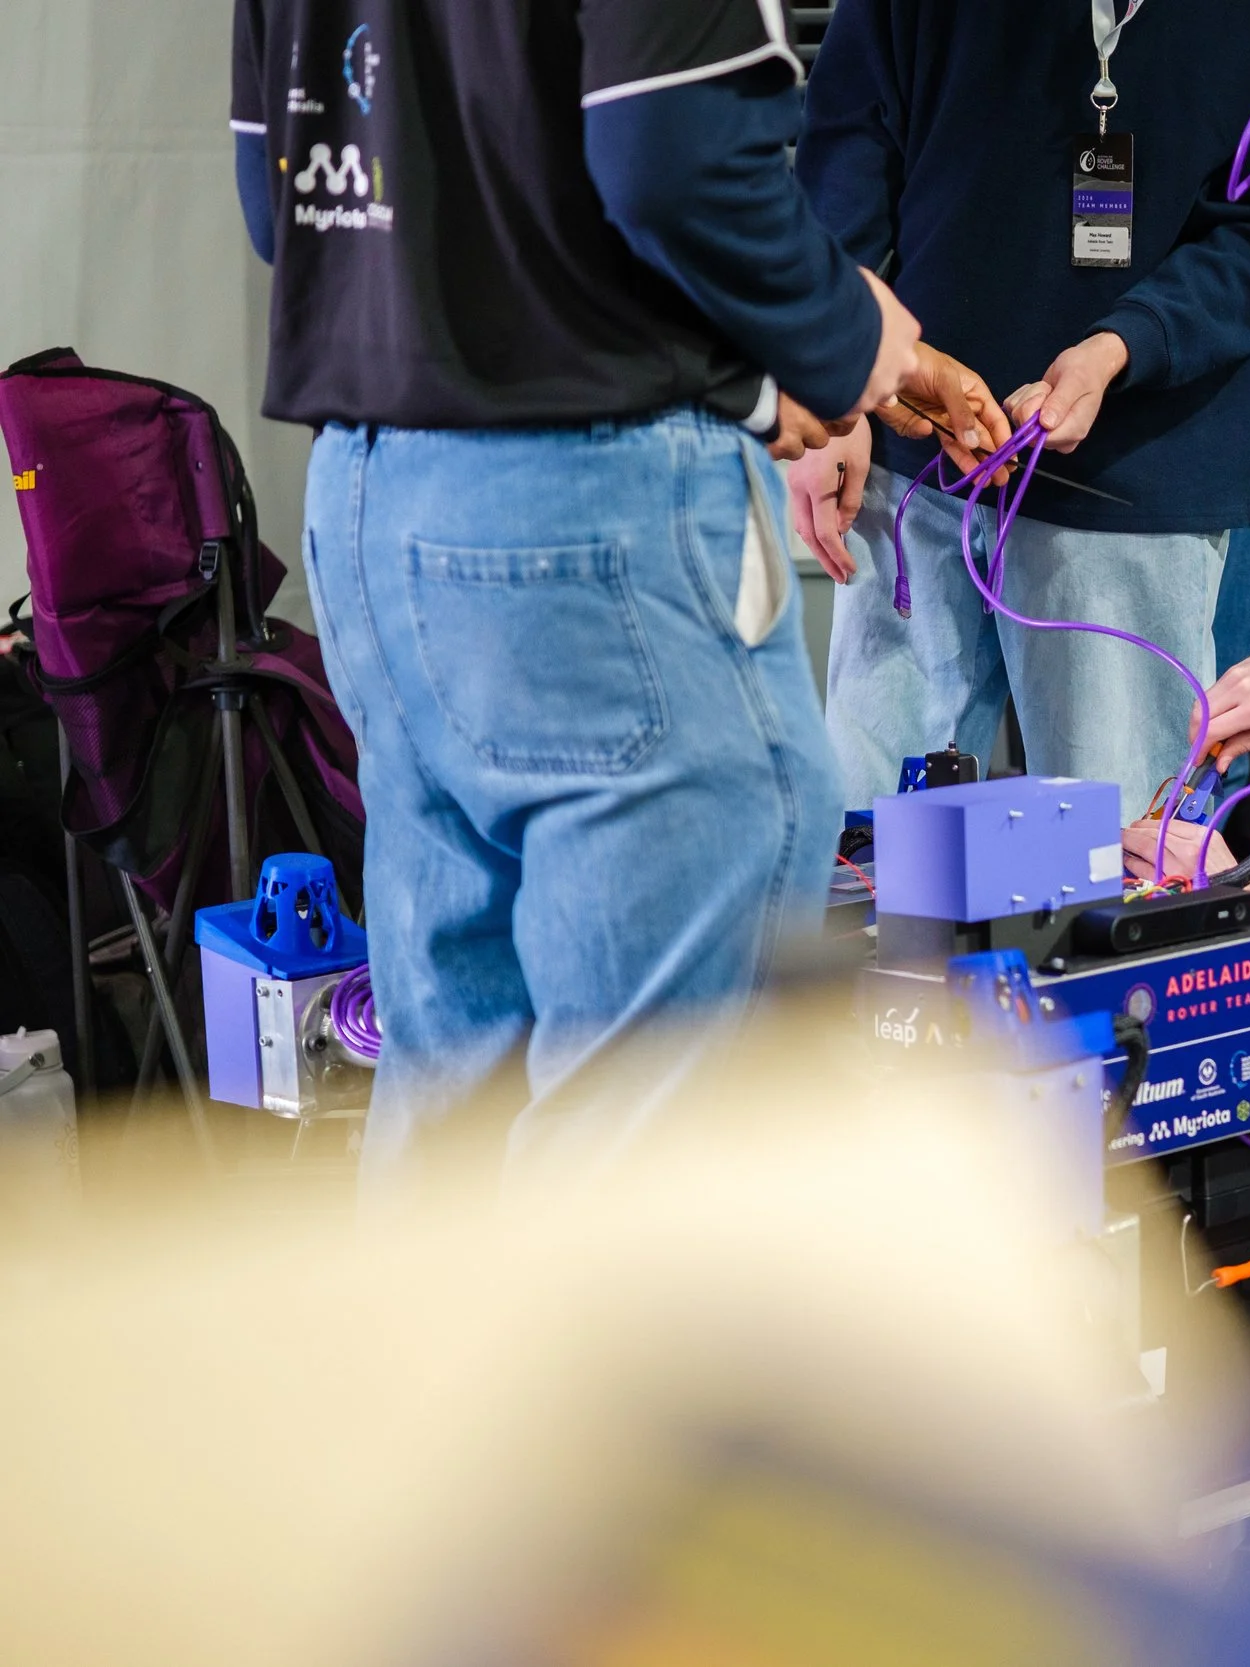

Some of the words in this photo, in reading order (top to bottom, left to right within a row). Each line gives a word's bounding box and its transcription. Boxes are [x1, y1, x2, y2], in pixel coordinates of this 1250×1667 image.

[1167, 1000, 1218, 1023] ROVER
[874, 1013, 918, 1049] leap
[1173, 1108, 1231, 1138] Myriota
